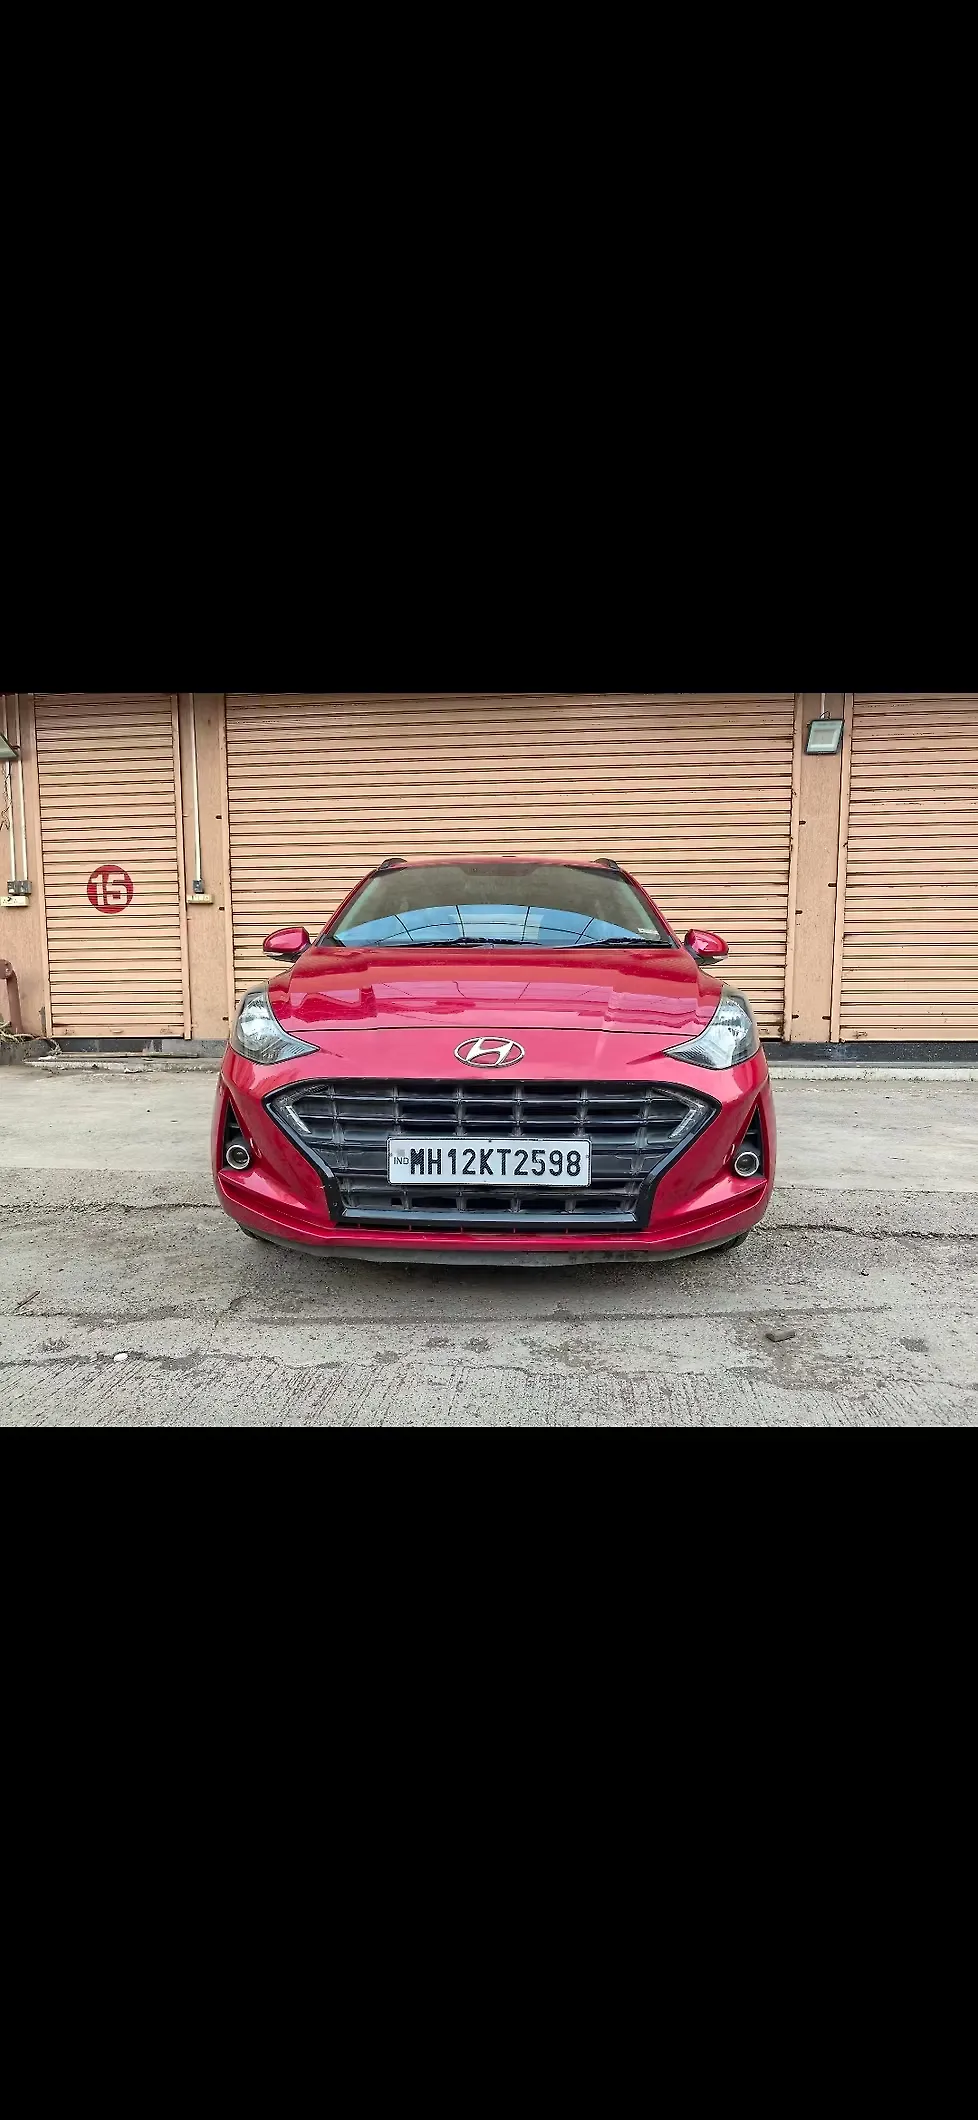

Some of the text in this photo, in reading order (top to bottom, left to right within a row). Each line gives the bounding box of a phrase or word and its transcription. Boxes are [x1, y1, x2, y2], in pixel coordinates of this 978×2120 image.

[91, 874, 128, 906] 15
[393, 1156, 410, 1165] IND
[410, 1148, 582, 1177] MH12KT2598
